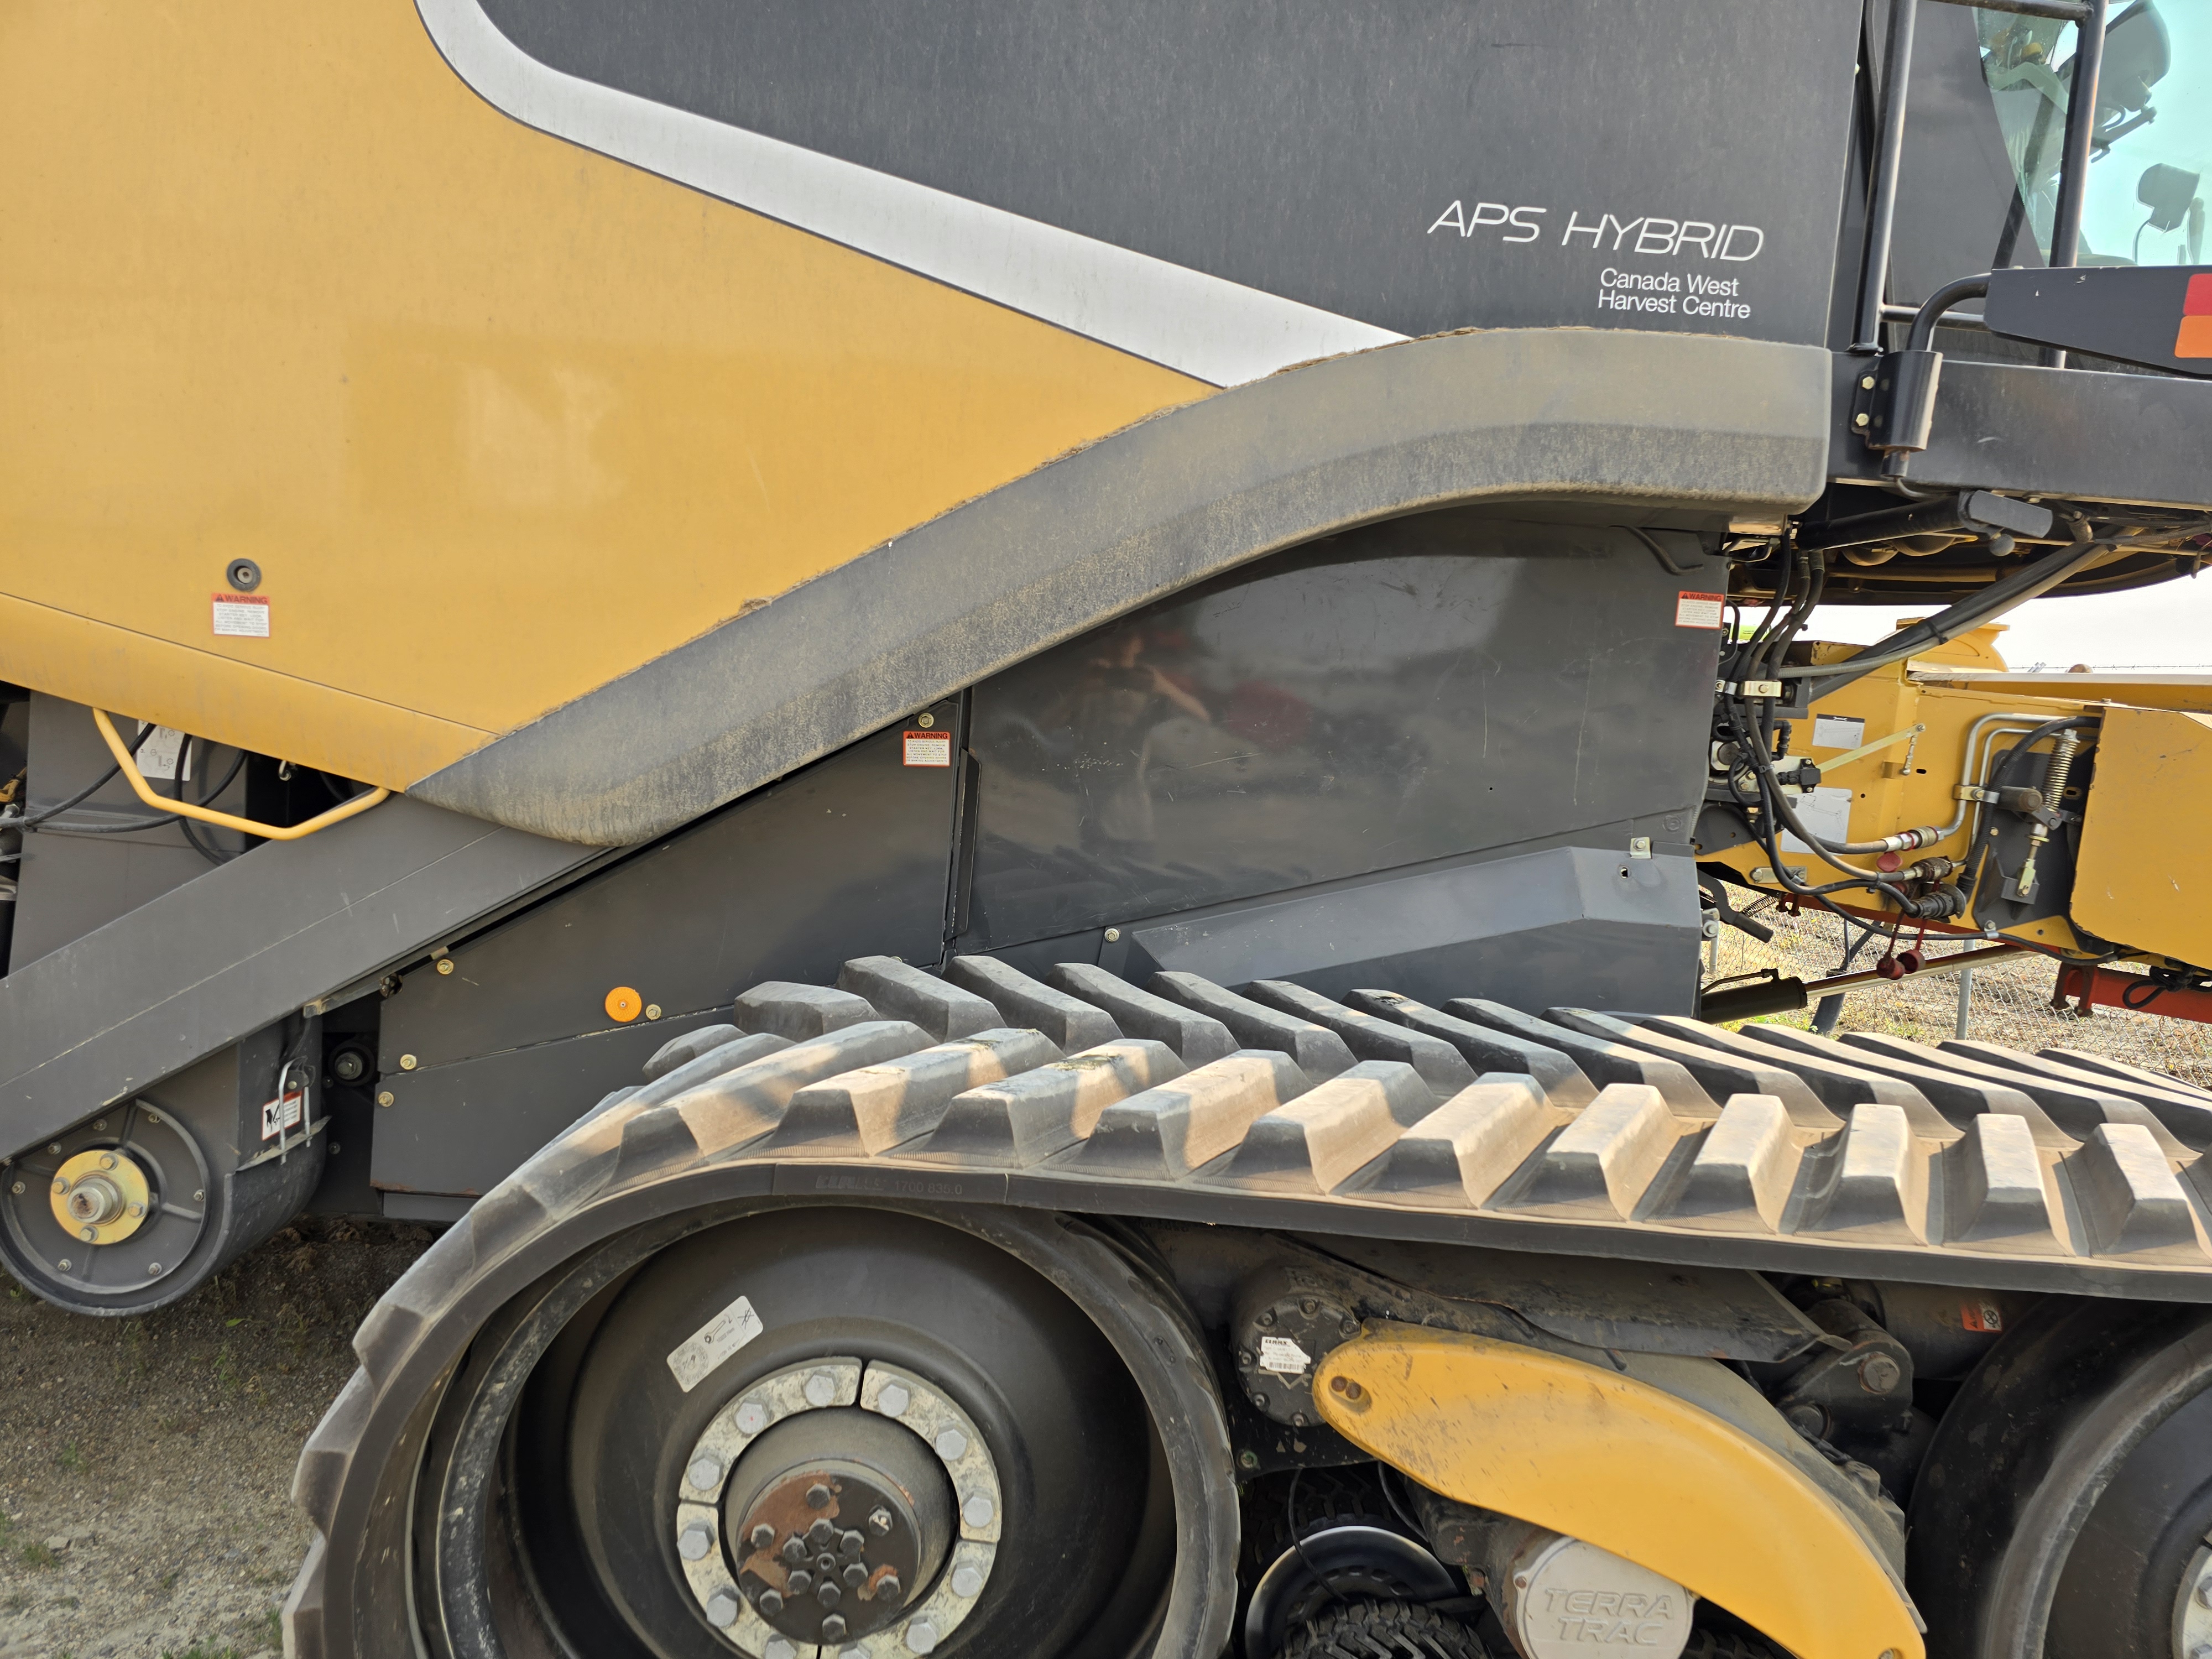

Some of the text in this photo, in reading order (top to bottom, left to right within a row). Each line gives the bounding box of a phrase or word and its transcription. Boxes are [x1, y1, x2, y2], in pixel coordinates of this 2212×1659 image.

[1427, 200, 1764, 262] APS HYBRID
[1600, 268, 1739, 296] Canada West
[1598, 289, 1751, 319] Harvest Centre
[225, 595, 268, 604] WARNING
[1689, 593, 1721, 602] WARNING
[894, 1180, 924, 1193] 1700
[927, 1183, 963, 1194] 835.0
[1545, 1588, 1674, 1619] TERRA
[1557, 1615, 1664, 1646] TRAC
